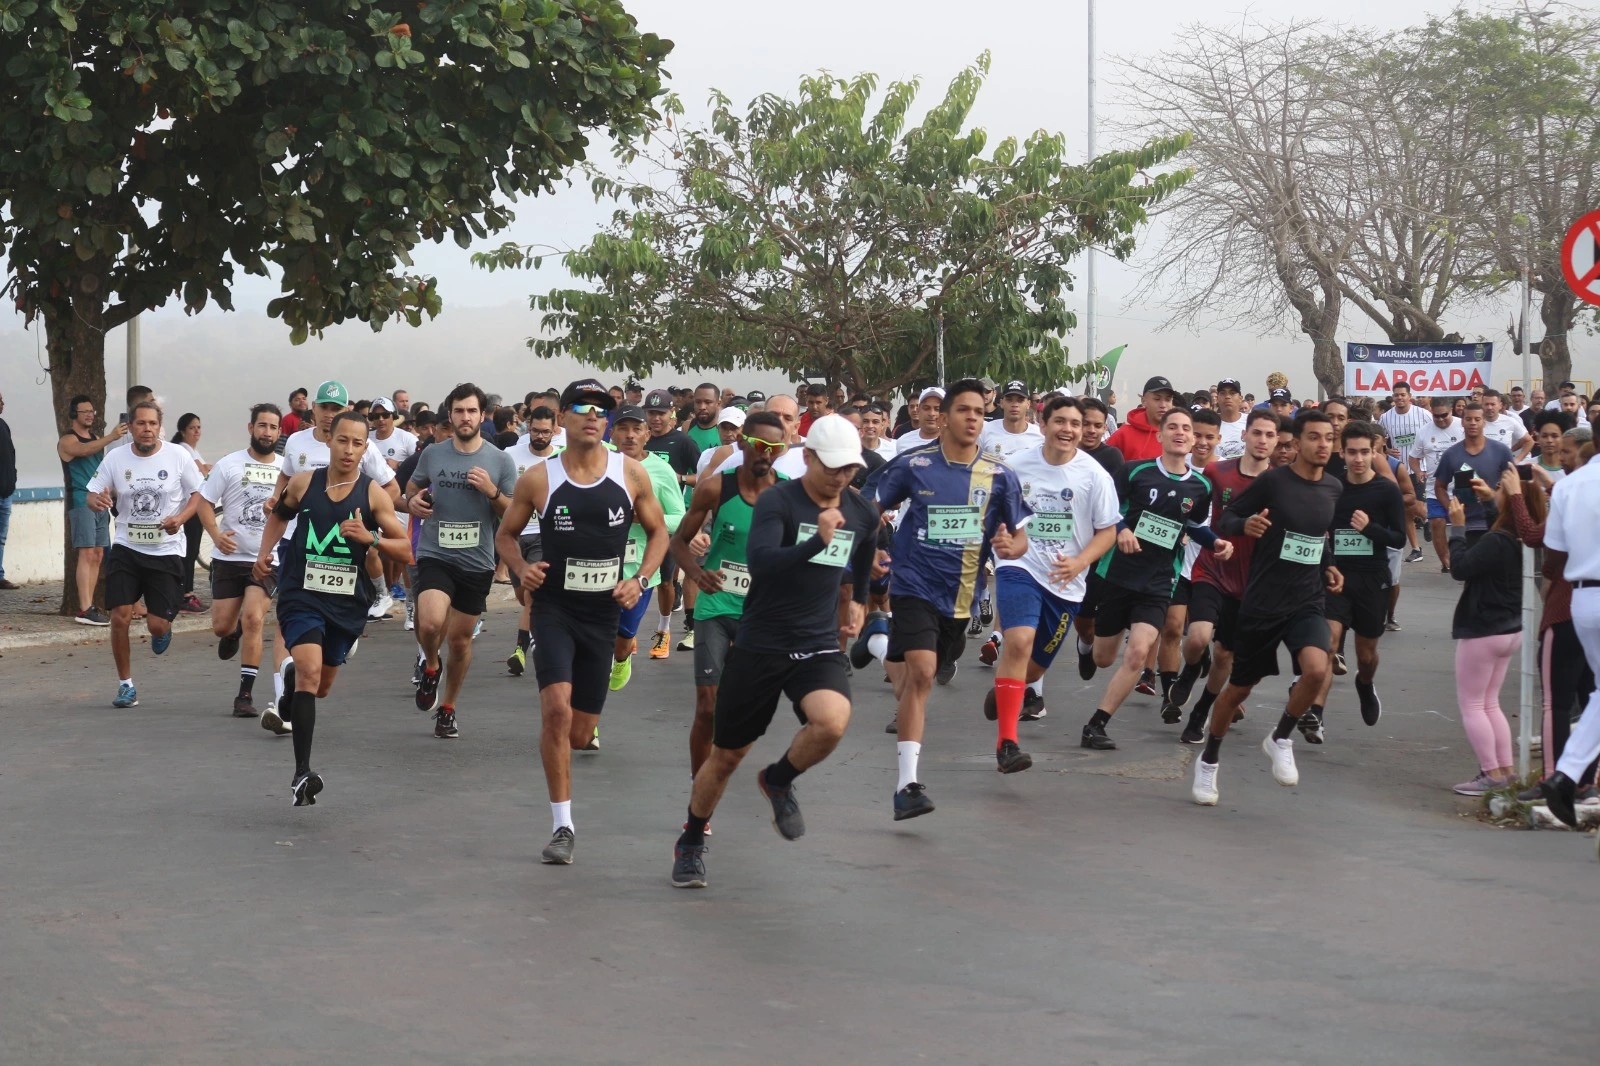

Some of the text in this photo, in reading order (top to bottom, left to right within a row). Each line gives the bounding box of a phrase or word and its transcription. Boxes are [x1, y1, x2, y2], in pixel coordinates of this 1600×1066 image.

[1378, 350, 1418, 358] MARINHA
[1434, 350, 1465, 358] BRASIL
[437, 469, 467, 479] A vid
[439, 481, 475, 490] corrid
[1149, 488, 1158, 505] 9
[942, 518, 967, 529] 327
[1038, 522, 1061, 532] 326
[1147, 524, 1168, 538] 335
[449, 532, 468, 541] 141
[1343, 538, 1362, 547] 347
[1295, 545, 1315, 557] 301
[314, 563, 350, 572] DELPIRAPORA
[320, 574, 344, 587] 129
[582, 573, 607, 583] 117
